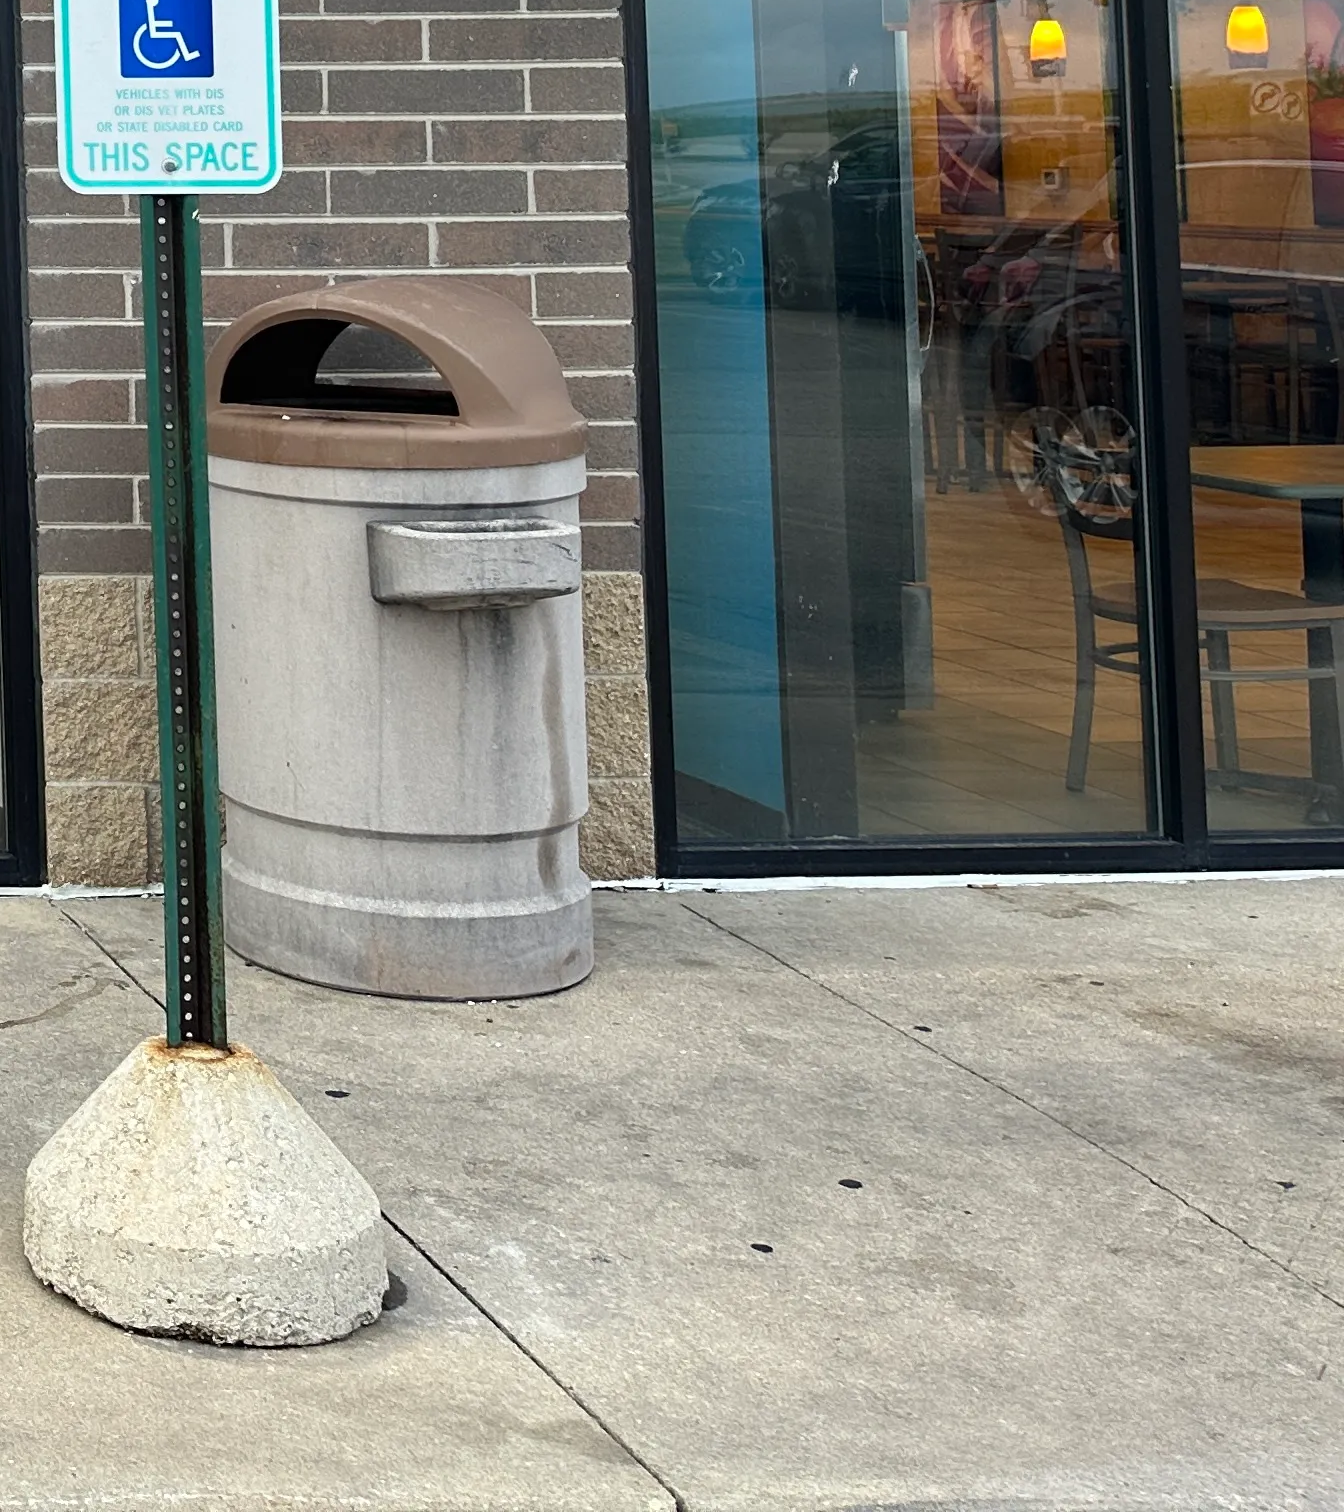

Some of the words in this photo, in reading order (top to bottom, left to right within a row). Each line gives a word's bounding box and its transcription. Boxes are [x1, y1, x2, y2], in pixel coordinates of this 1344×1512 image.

[116, 88, 170, 100] VEHICLES
[174, 88, 201, 99] WITH
[206, 88, 224, 99] DIS
[114, 105, 130, 116] OR
[134, 105, 153, 116] DIS
[158, 105, 179, 116] VET
[183, 105, 225, 116] PLATES
[96, 121, 112, 132] OR
[117, 121, 148, 132] STATE
[153, 121, 209, 132] DISABLED
[213, 121, 243, 132] CARD
[83, 142, 150, 172] THIS
[165, 142, 259, 172] SPACE
